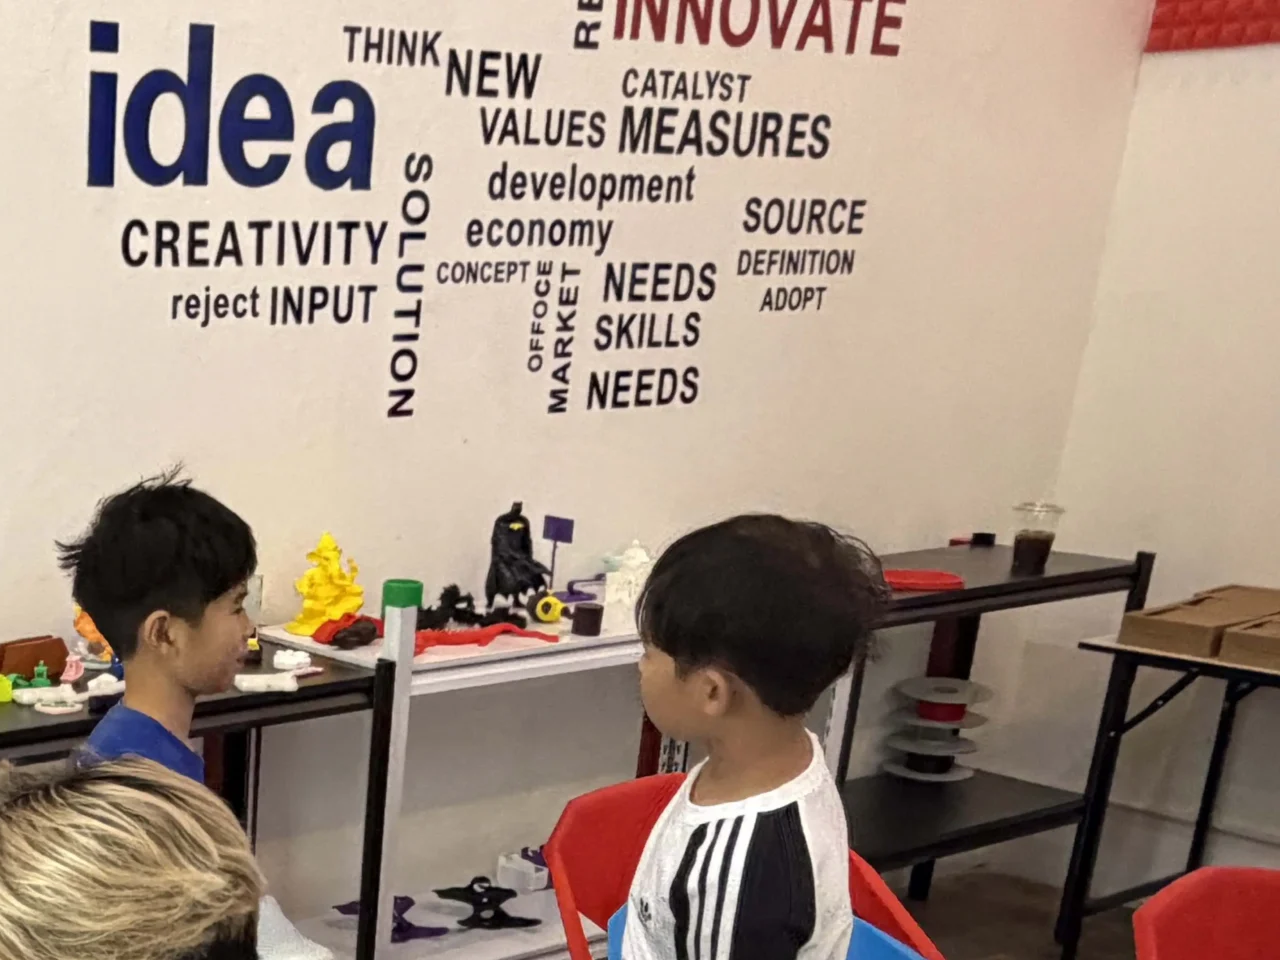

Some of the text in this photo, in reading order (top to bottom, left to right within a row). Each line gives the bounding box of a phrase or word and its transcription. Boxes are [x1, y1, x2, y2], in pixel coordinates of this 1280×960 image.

[343, 25, 442, 67] THINK
[613, 0, 907, 57] INNOVATE
[445, 47, 542, 99] NEW
[621, 67, 752, 102] CATALYST
[86, 20, 376, 192] idea
[479, 106, 607, 149] VALUES
[618, 105, 832, 160] MEASURES
[487, 161, 696, 211] development
[465, 217, 614, 257] economy
[742, 197, 867, 235] SOURCE
[121, 219, 388, 268] CREATIVITY
[736, 249, 855, 275] DEFINITION
[386, 152, 434, 418] SOLUTION
[436, 261, 531, 284] CONCEPT
[602, 262, 717, 303] NEEDS
[171, 285, 260, 328] reject
[269, 285, 378, 325] INPUT
[527, 260, 553, 372] OFFOCE
[758, 287, 827, 312] ADOPT
[547, 261, 581, 413] MARKET
[593, 312, 701, 351] SKILLS
[586, 366, 700, 411] NEEDS
